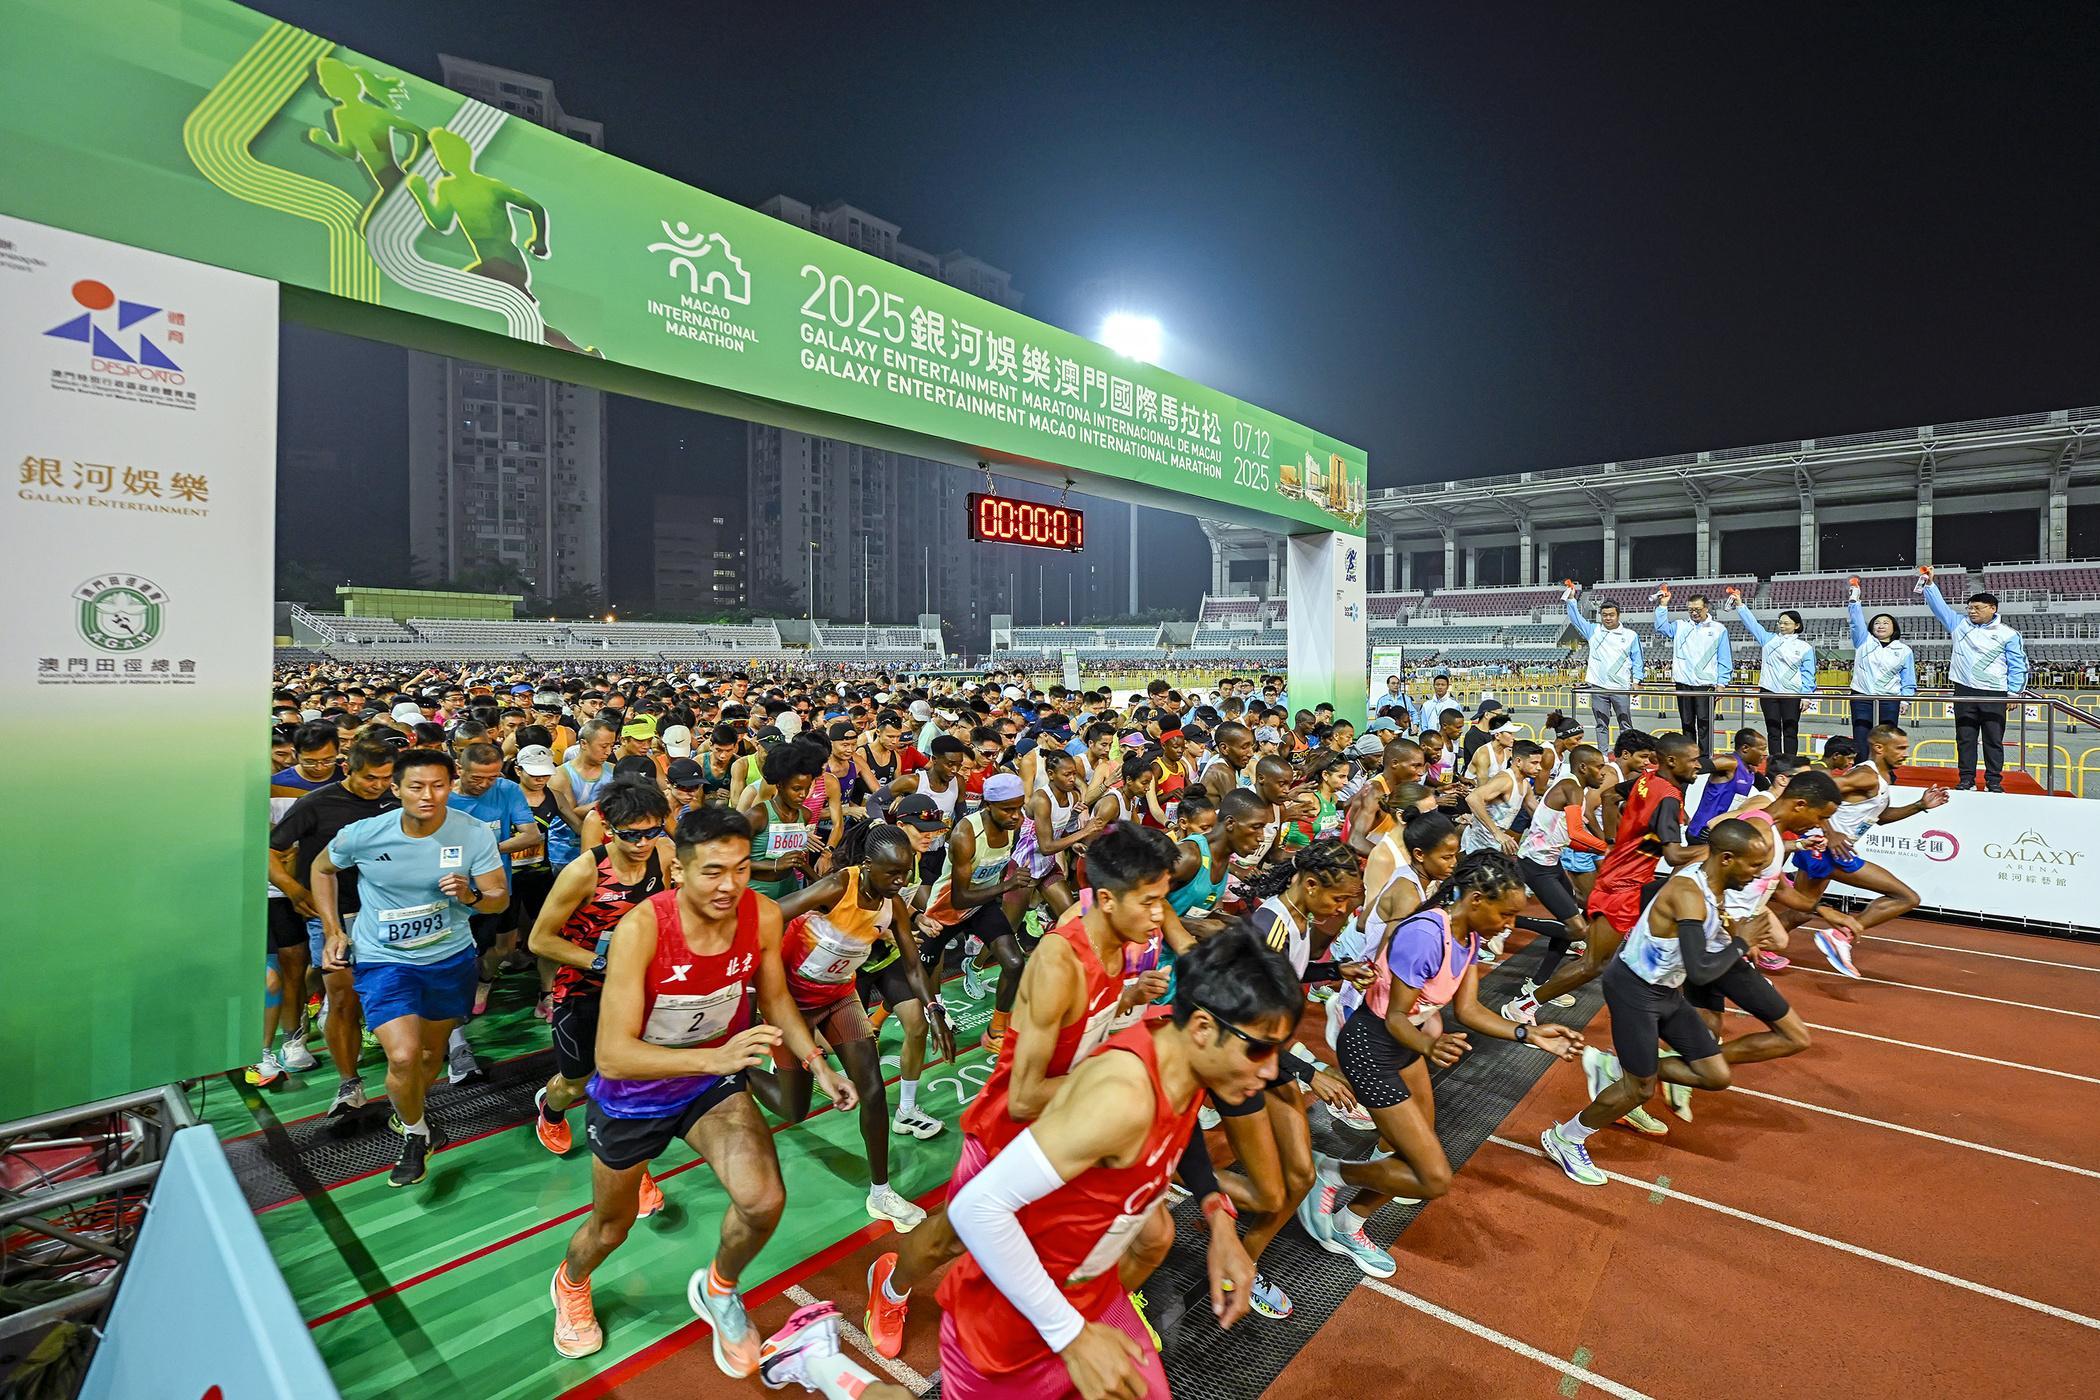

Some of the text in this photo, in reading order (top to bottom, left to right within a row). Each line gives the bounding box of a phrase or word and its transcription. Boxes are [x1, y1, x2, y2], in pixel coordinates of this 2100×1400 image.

[647, 299, 760, 343] INTERNATIONAL
[681, 294, 730, 319] MACAO
[666, 320, 744, 353] MARATHON
[800, 323, 1222, 463] GALAXY ENTERTAINMENT MARATONA INTERNACIONAL DE MACAU
[800, 348, 1222, 480] GALAXY ENTERTAINMENT MACAO INTERNATIONAL MARATHON
[1233, 420, 1271, 459] 07.12
[18, 455, 209, 503] 銀河娛樂
[1233, 457, 1270, 492] 2025
[981, 498, 1082, 545] 00:00:01
[774, 834, 804, 849] B6602
[1866, 833, 1943, 853] 澳門百老匯
[1983, 843, 2080, 866] GALAXY
[2006, 864, 2058, 873] ARENA
[389, 914, 443, 941] B2993
[827, 959, 850, 974] 62
[687, 1012, 704, 1032] 2
